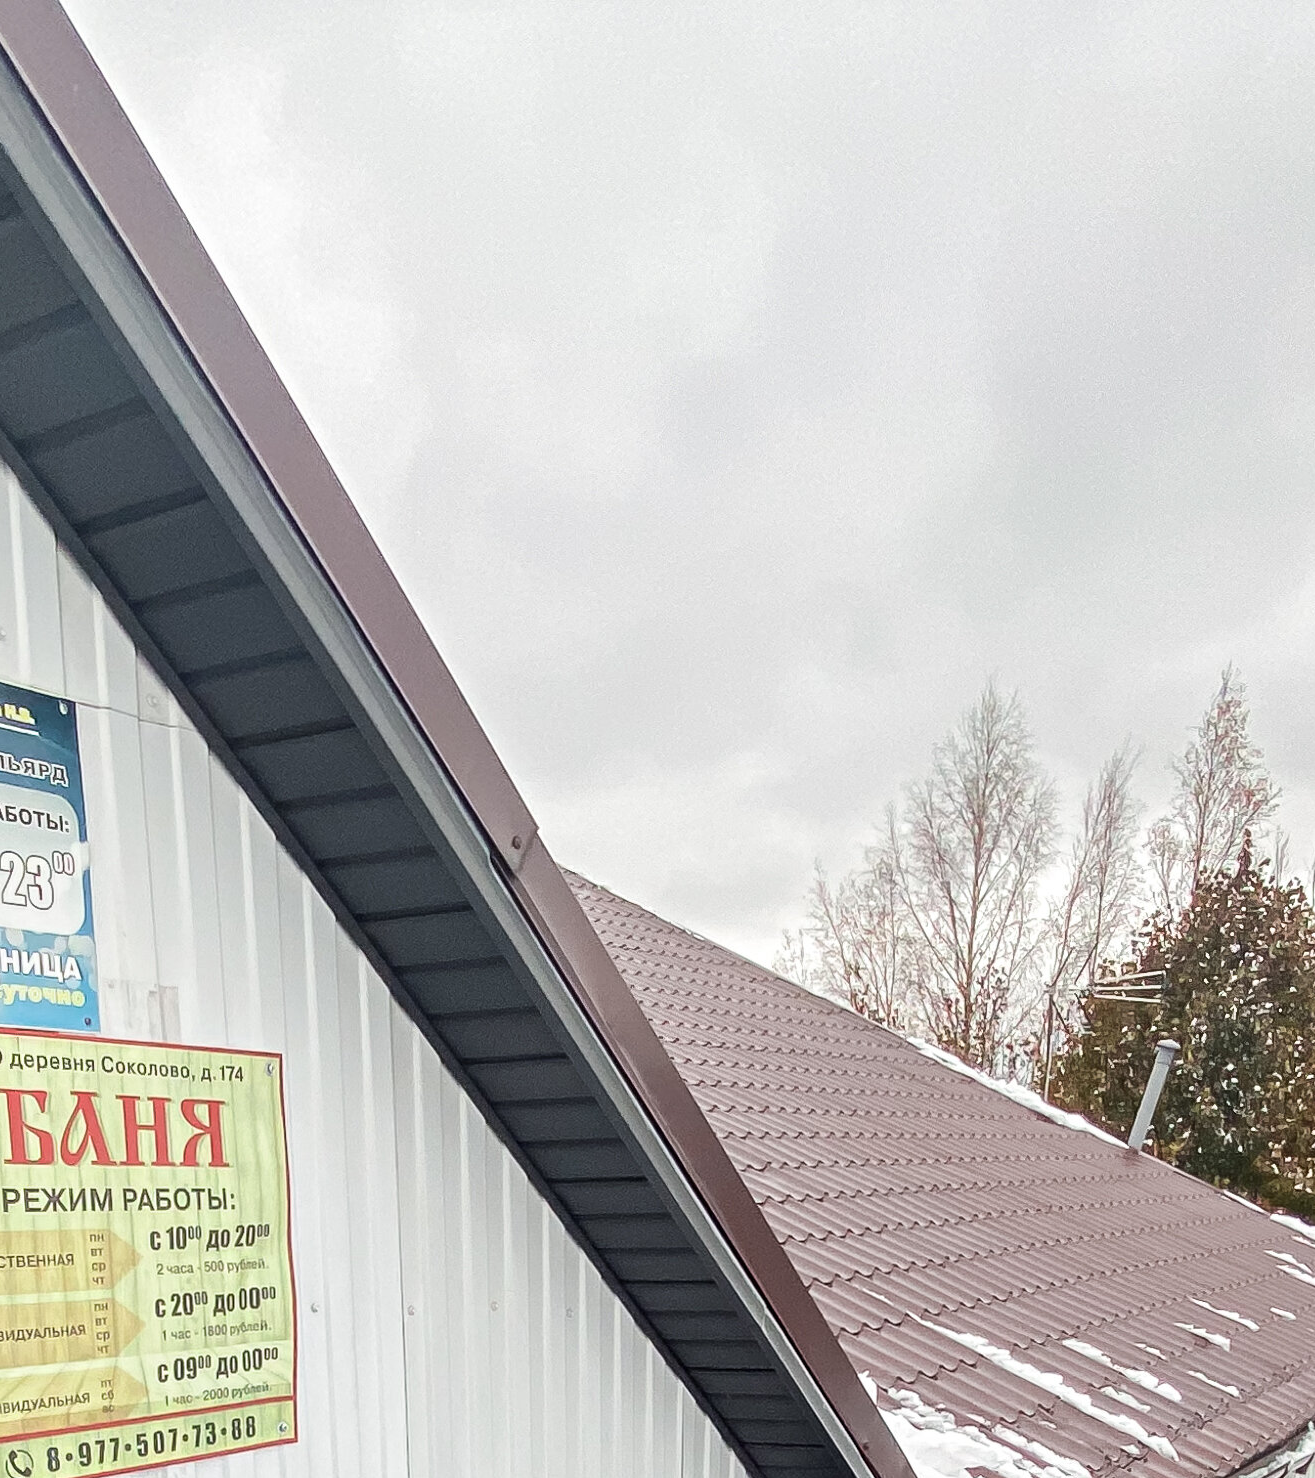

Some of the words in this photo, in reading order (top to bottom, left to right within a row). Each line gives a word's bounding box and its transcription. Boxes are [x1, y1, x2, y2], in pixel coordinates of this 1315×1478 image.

[10, 1052, 95, 1072] деревня
[101, 1055, 196, 1082] Соколово,
[219, 1065, 244, 1083] 174
[2, 1187, 113, 1213] РЕЖИМ
[123, 1187, 237, 1212] РАБОТЫ:
[89, 1233, 104, 1243] пн
[206, 1229, 231, 1252] до
[90, 1248, 104, 1257] вт
[91, 1261, 107, 1273] ср
[156, 1263, 164, 1275] 2
[166, 1264, 194, 1275] часа
[204, 1260, 224, 1273] 500
[227, 1258, 269, 1273] рублей.
[92, 1276, 105, 1285] чт
[94, 1302, 109, 1312] пн
[213, 1293, 235, 1317] до
[95, 1317, 108, 1326] вт
[162, 1329, 167, 1341] 1
[170, 1330, 191, 1340] час
[203, 1324, 227, 1337] 1800
[229, 1320, 272, 1336] рублей.
[96, 1331, 110, 1343] ср
[97, 1345, 110, 1354] чт
[216, 1355, 238, 1379] до
[100, 1379, 113, 1388] пт
[101, 1390, 114, 1401] сб
[173, 1394, 192, 1405] час
[202, 1387, 229, 1402] 2000
